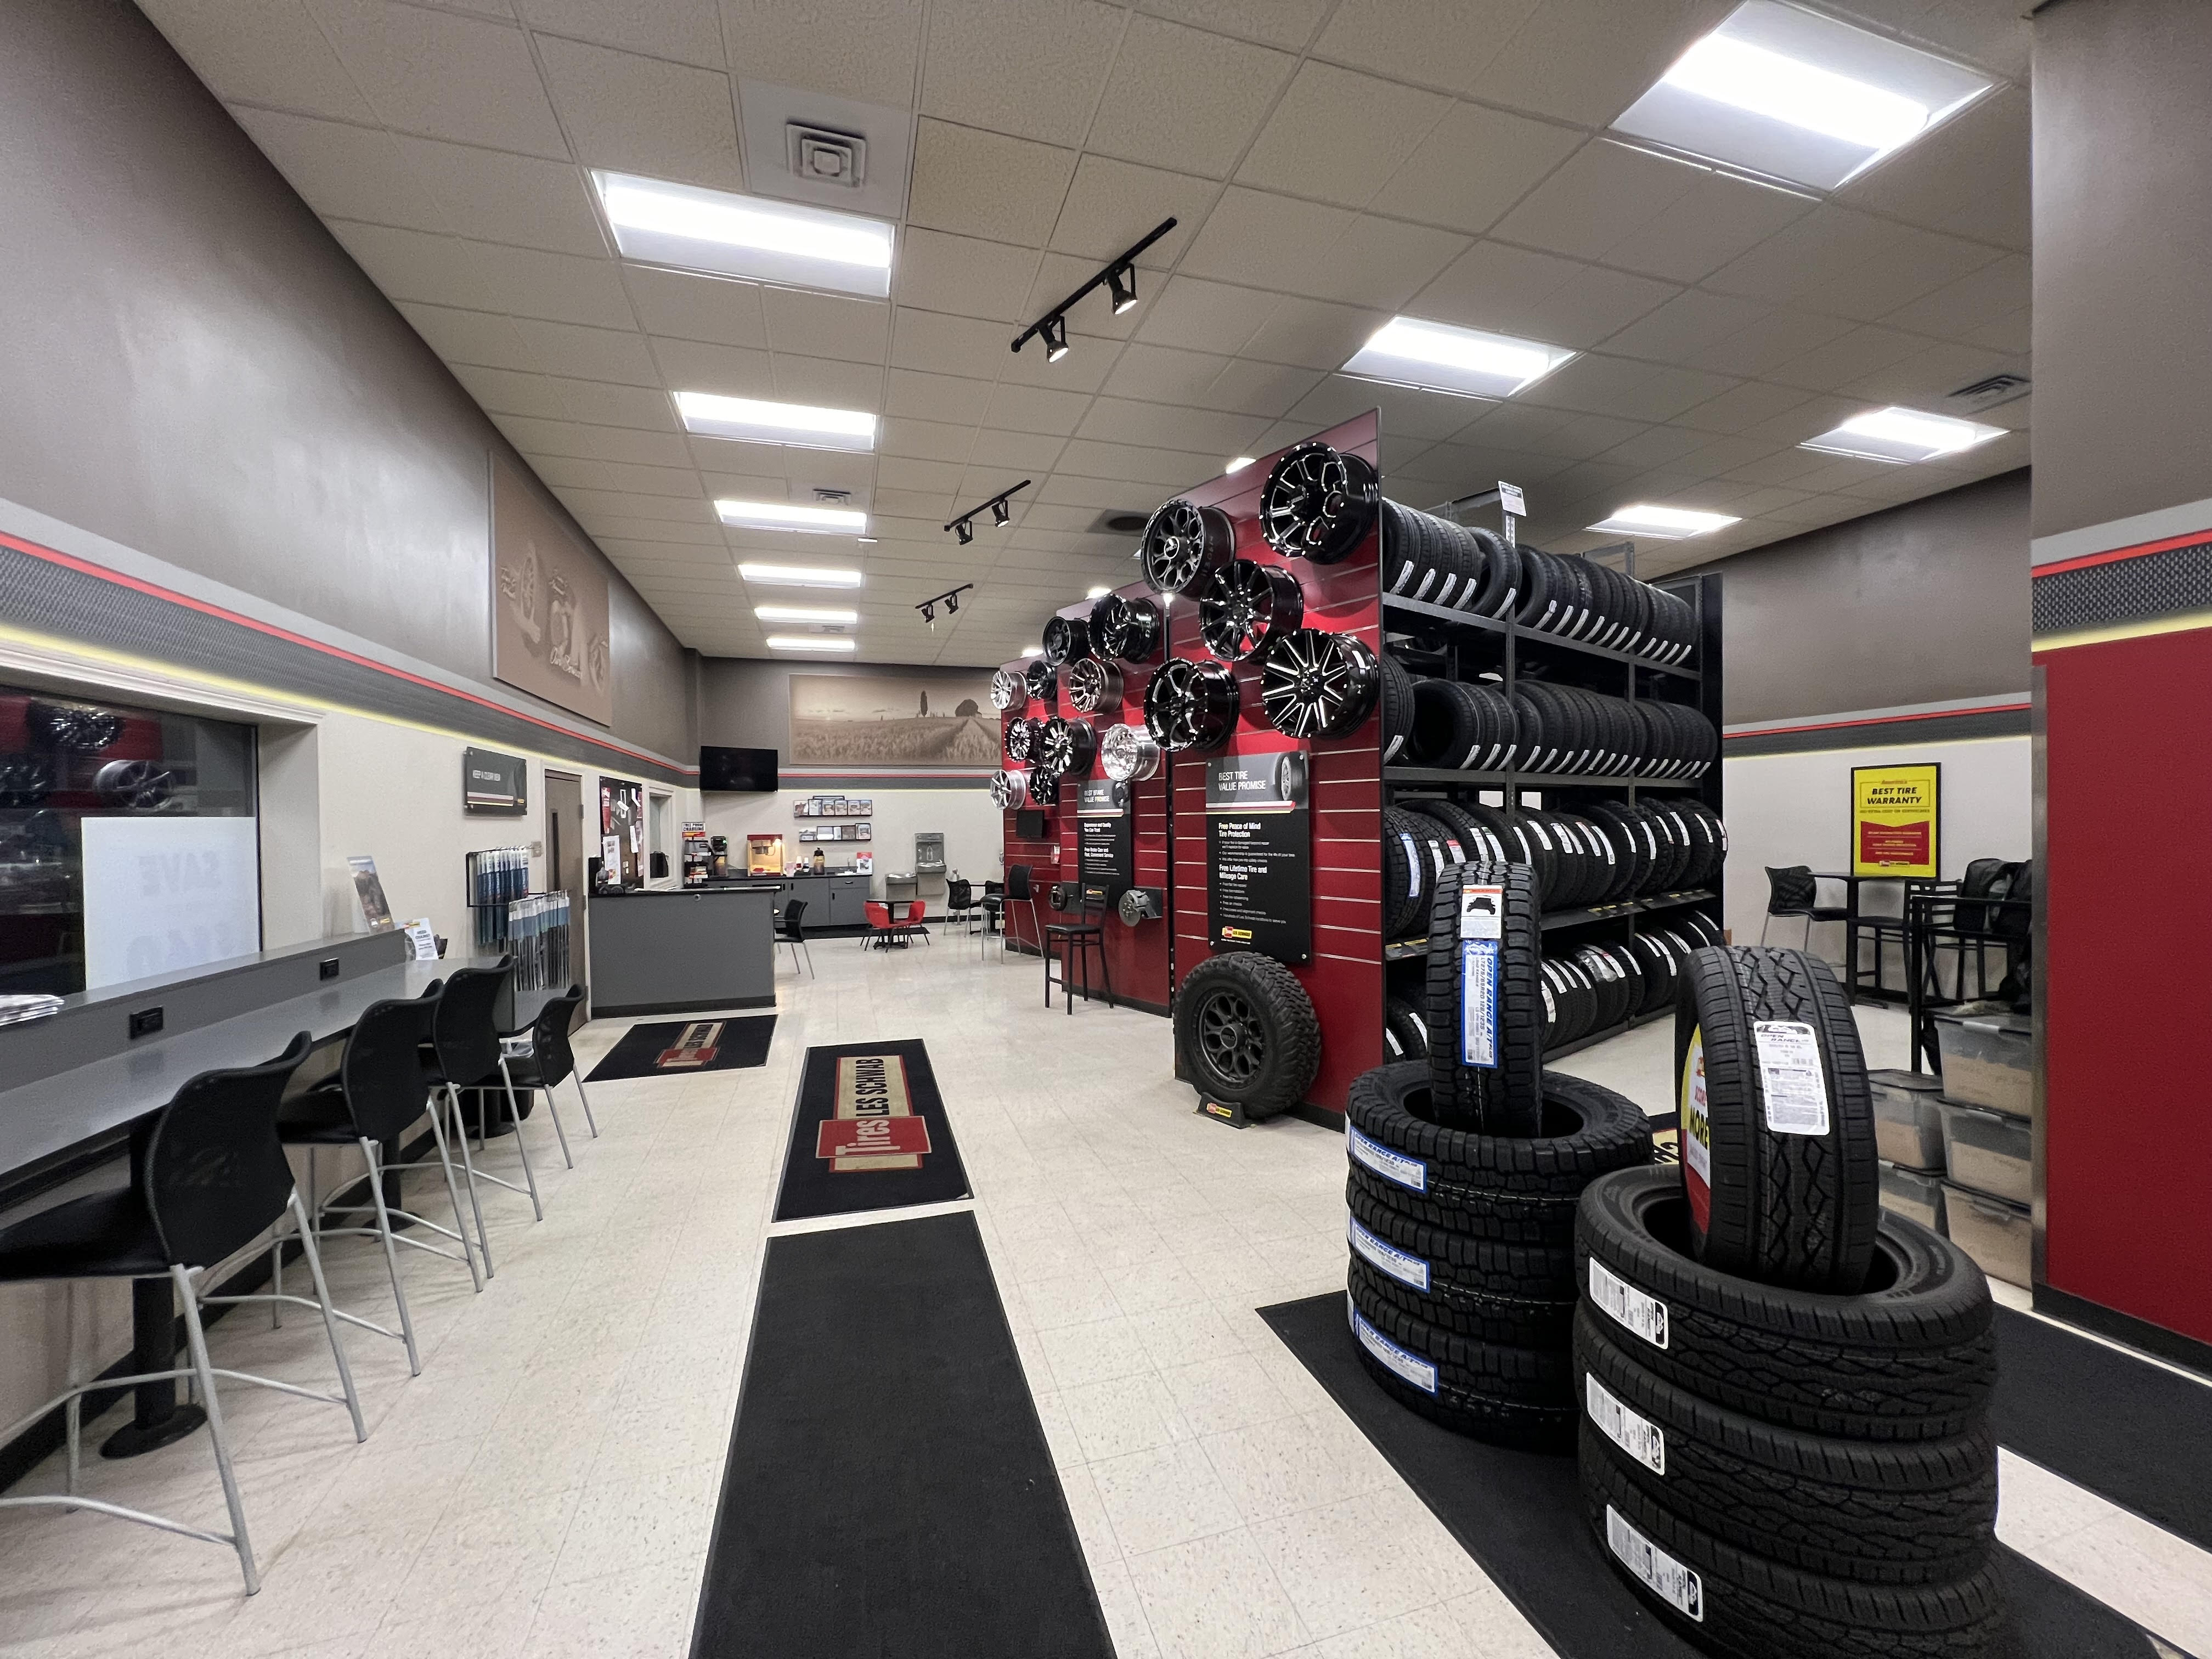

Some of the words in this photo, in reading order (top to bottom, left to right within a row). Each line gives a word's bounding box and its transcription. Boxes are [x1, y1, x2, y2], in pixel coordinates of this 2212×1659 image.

[1218, 771, 1233, 781] BEST
[1234, 771, 1248, 780] TIRE
[1218, 781, 1237, 791] VALUE
[1238, 780, 1266, 791] PROMISE
[855, 1058, 888, 1095] SCHWAB
[855, 1098, 890, 1116] LES
[835, 1120, 901, 1155] Tires
[1368, 1143, 1391, 1158] RANGE
[1370, 1238, 1393, 1255] RANGE
